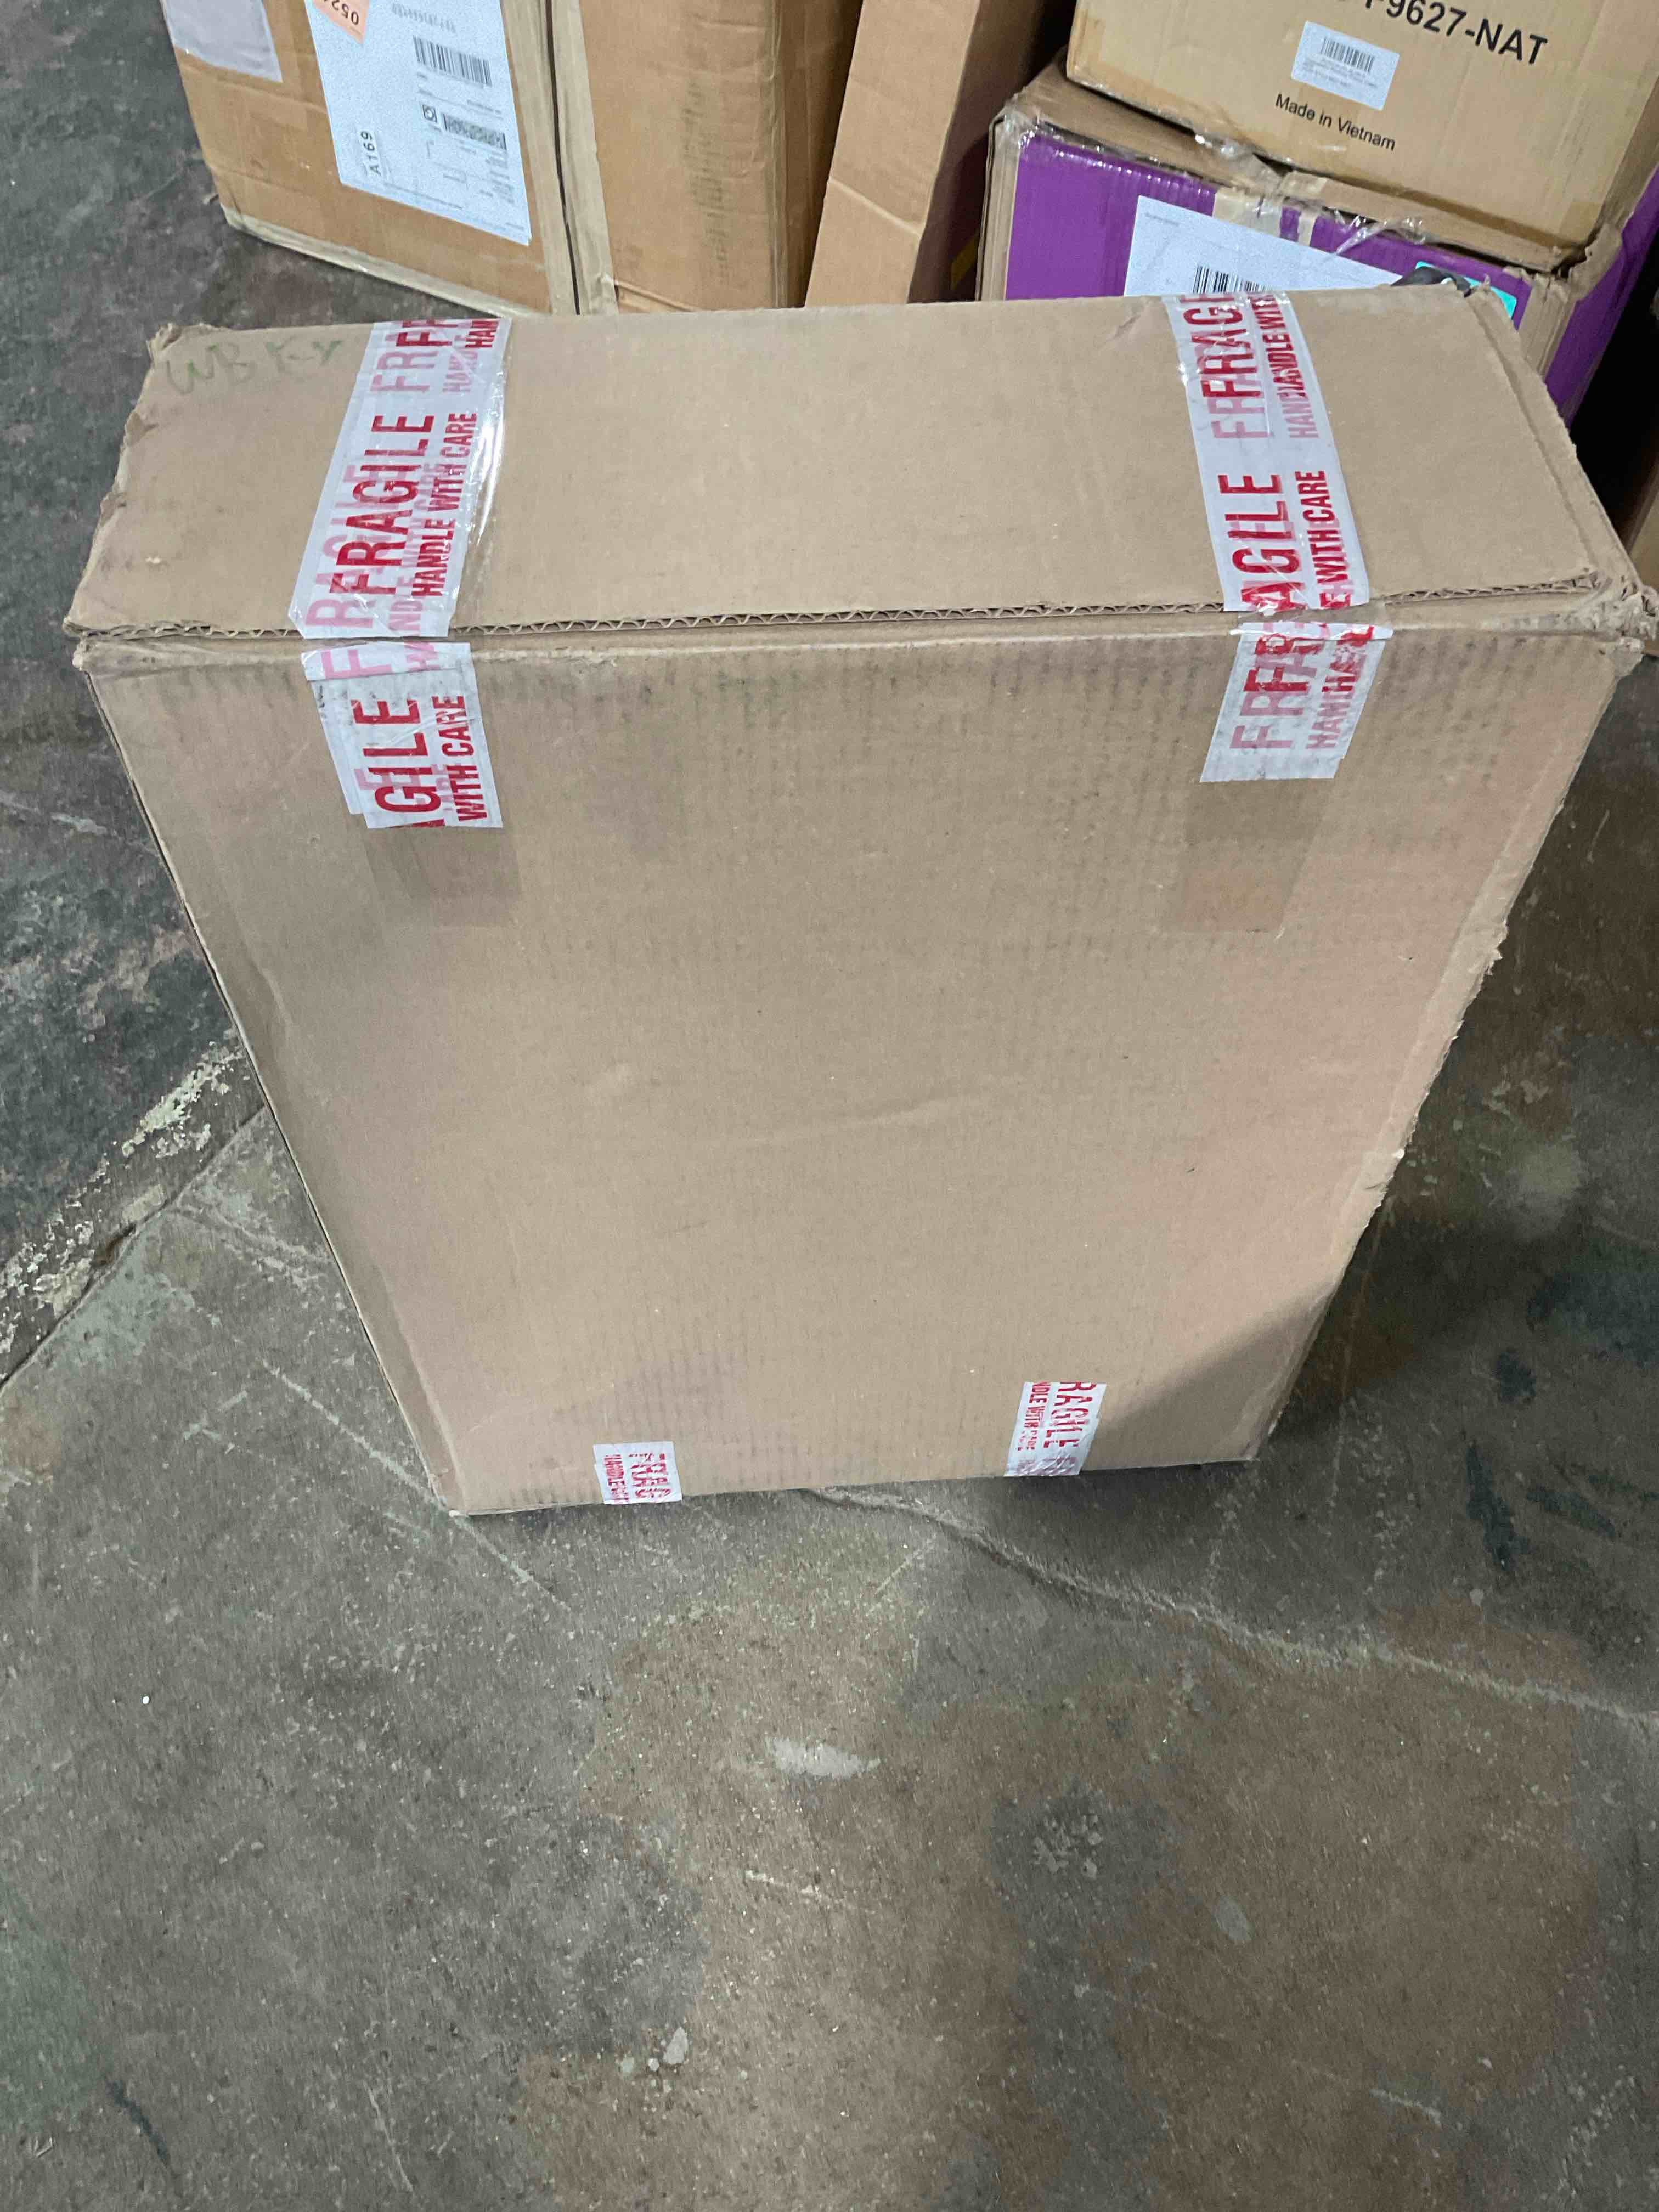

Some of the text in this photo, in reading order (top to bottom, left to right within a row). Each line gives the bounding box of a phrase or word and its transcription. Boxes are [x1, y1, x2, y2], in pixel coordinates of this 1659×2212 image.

[324, 0, 359, 25] 052
[1339, 0, 1548, 65] 9627-NAT
[1276, 94, 1395, 151] Made in Vietnam
[440, 413, 477, 459] CARE
[329, 415, 435, 595] FRAGILE
[427, 463, 467, 512] WITH
[1295, 470, 1335, 522] CARE
[411, 518, 456, 597] HANDLE
[1307, 529, 1349, 585] WITH
[432, 695, 476, 757] CARE
[350, 699, 445, 827] GILE
[446, 764, 488, 822] WITH
